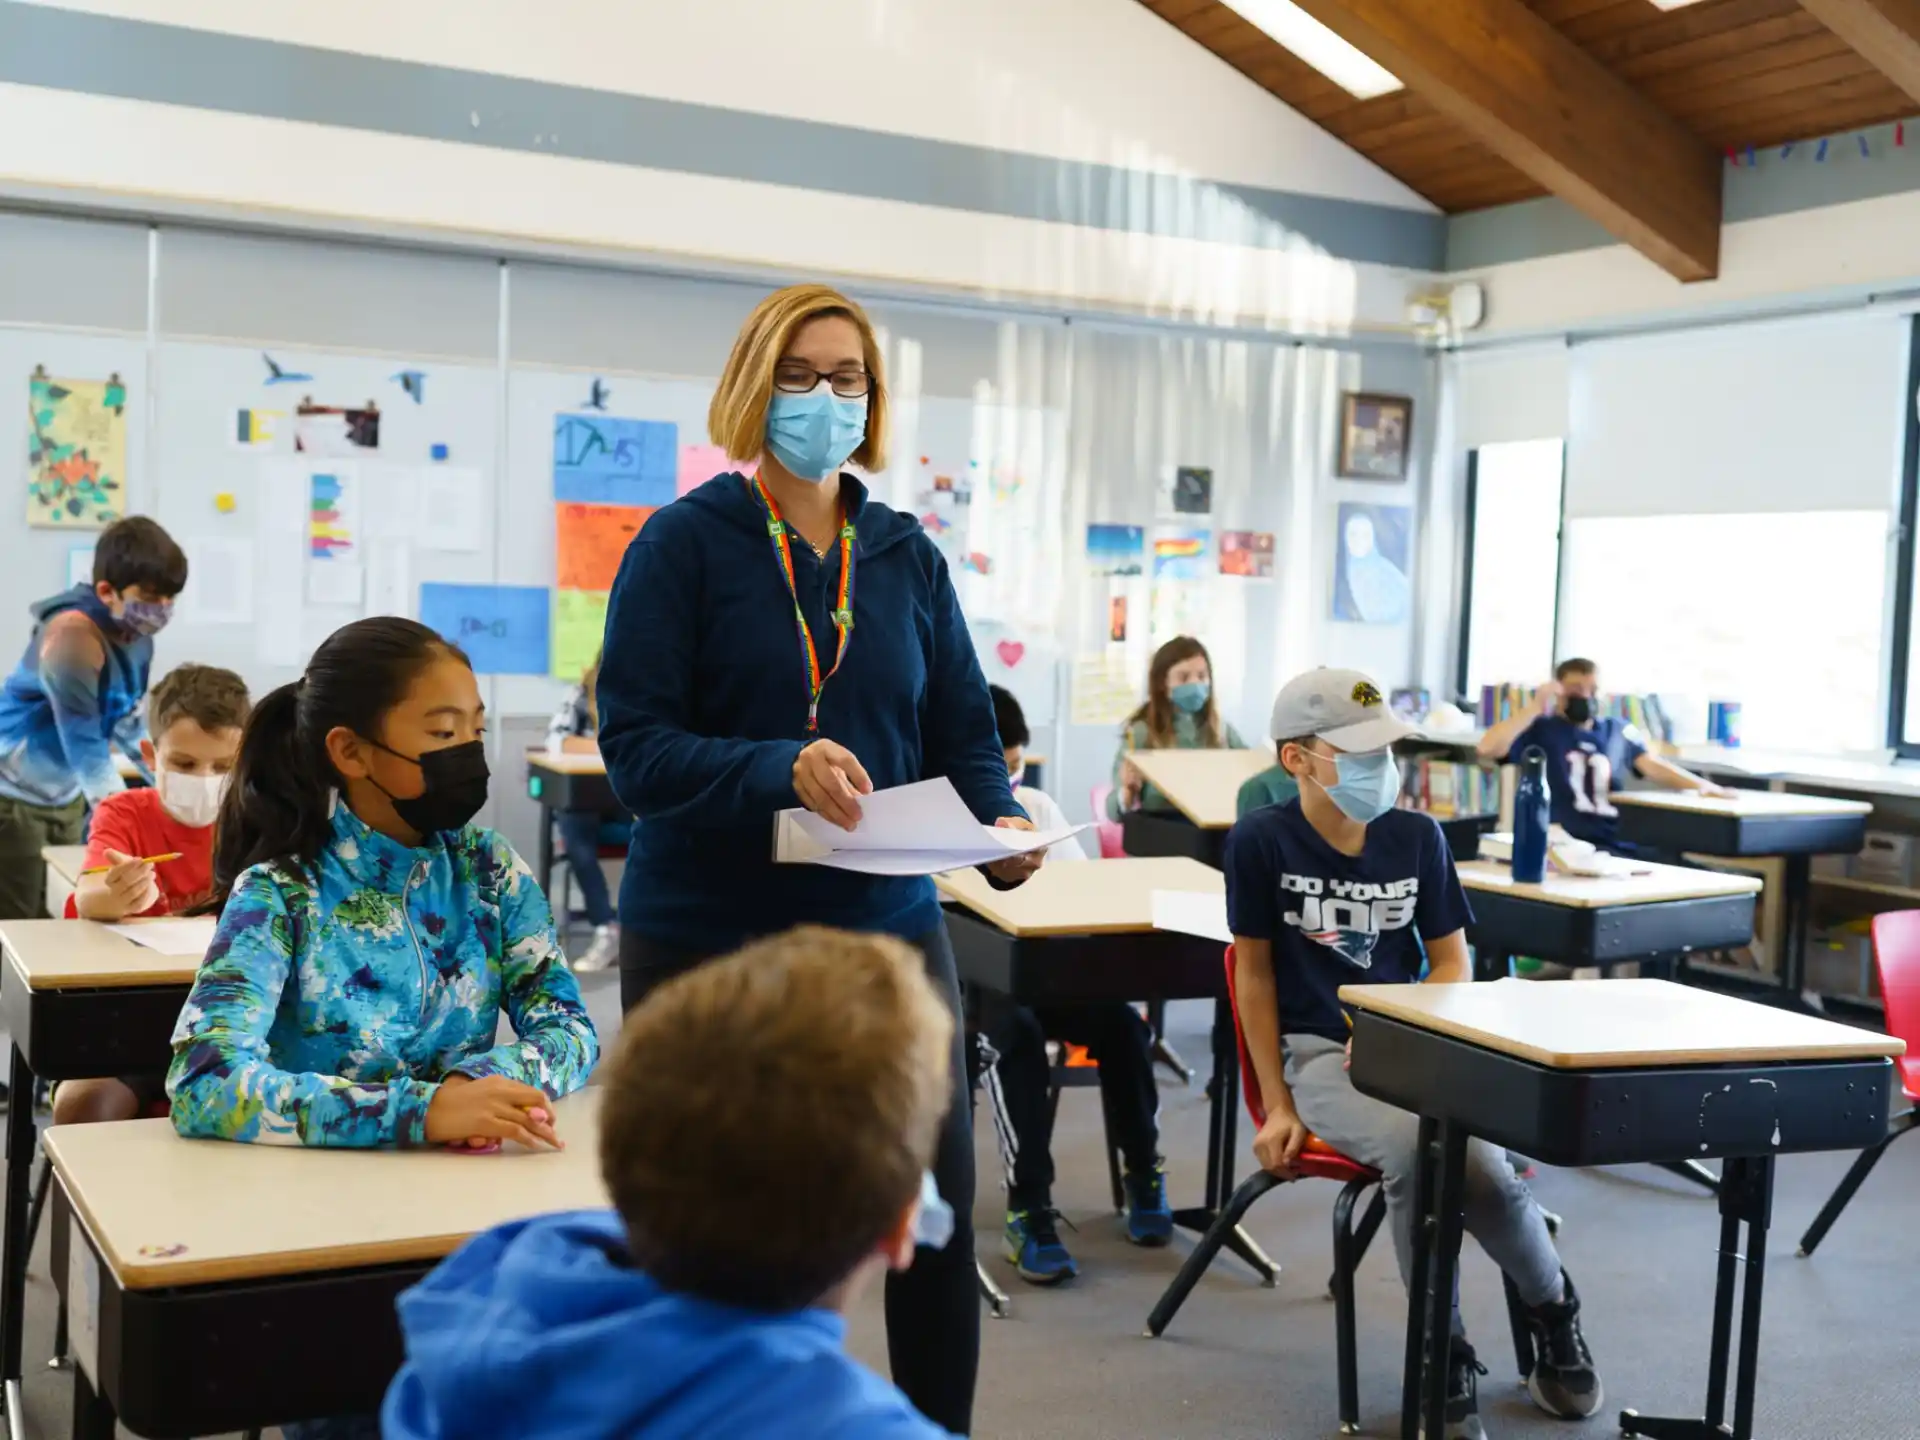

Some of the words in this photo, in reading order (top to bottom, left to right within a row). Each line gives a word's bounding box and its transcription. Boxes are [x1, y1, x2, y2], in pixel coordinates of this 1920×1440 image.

[1565, 750, 1619, 817] 11
[1280, 873, 1323, 895] DO
[1329, 877, 1418, 900] YOUR
[1283, 896, 1418, 932] JOB
